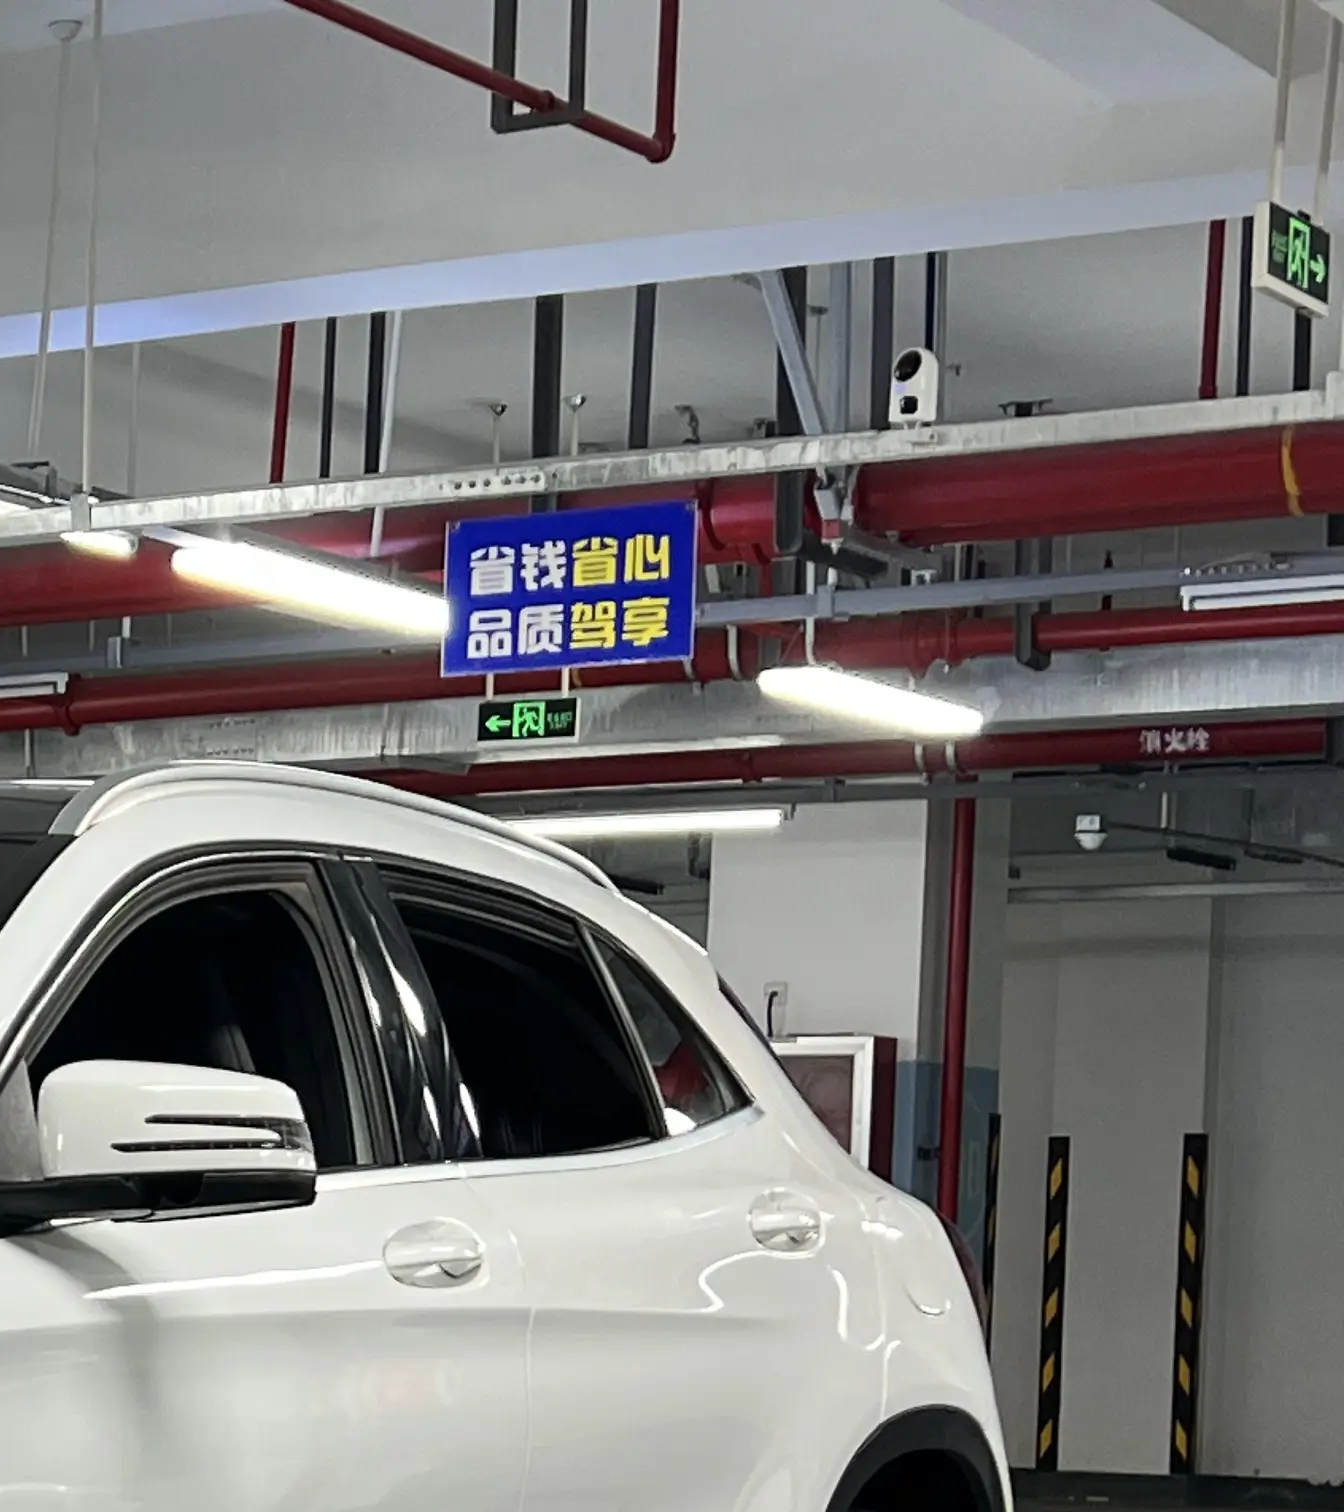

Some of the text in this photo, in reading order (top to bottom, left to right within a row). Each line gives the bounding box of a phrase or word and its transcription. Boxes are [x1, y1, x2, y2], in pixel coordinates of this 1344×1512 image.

[469, 533, 671, 597] 省钱省心
[466, 597, 671, 660] 品质驾享
